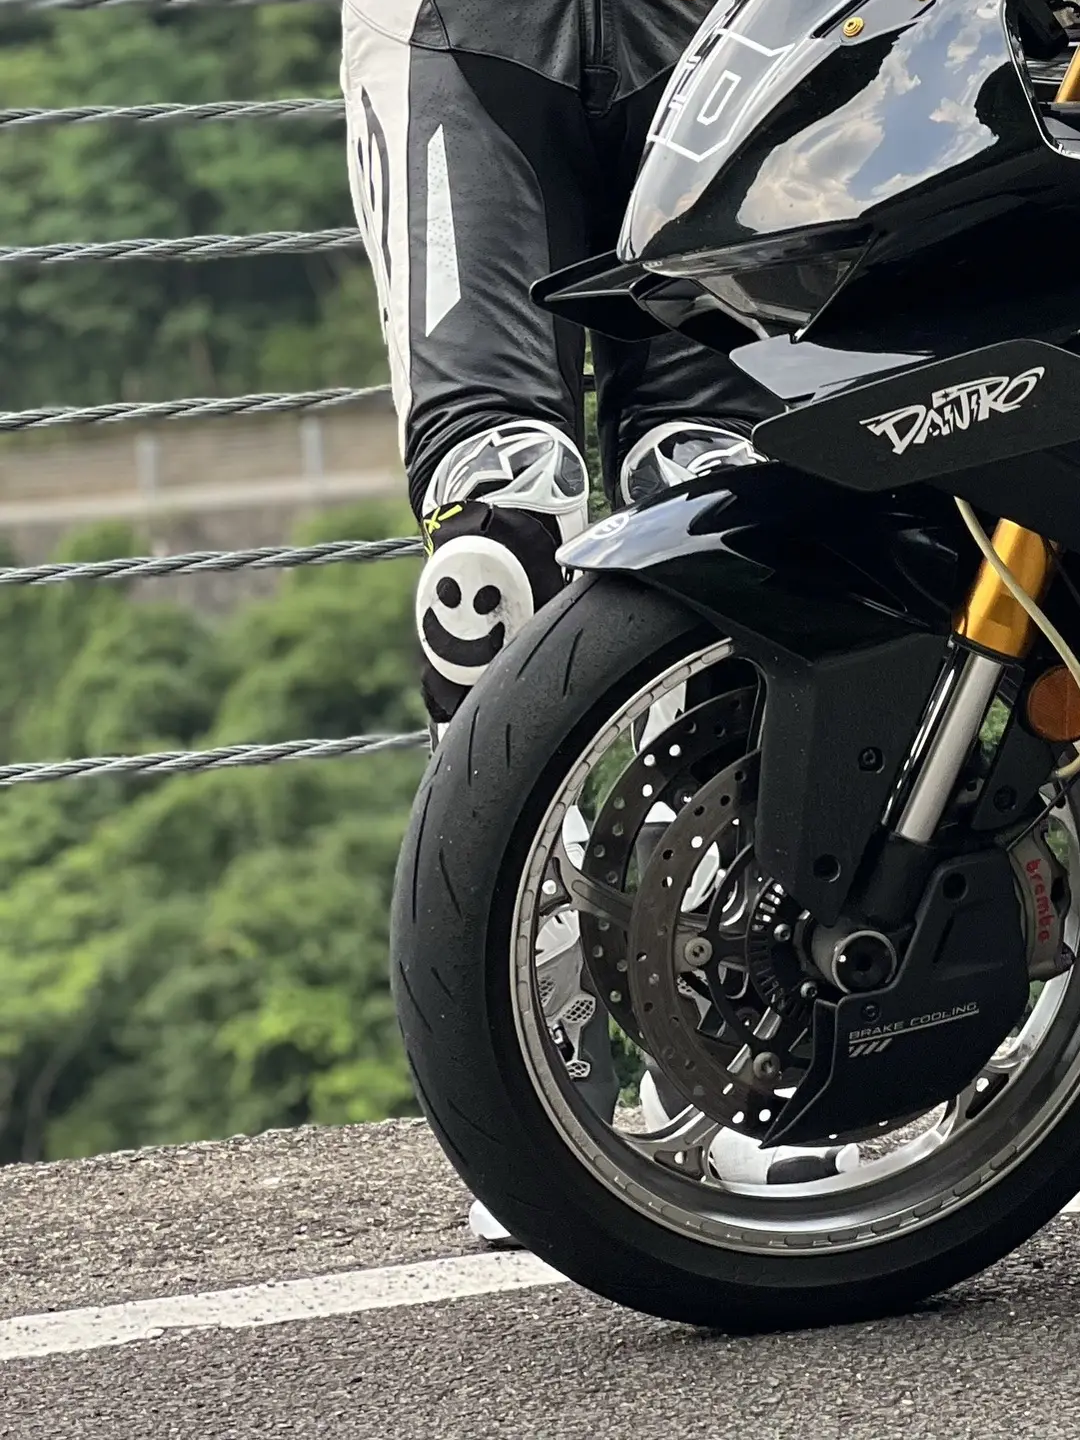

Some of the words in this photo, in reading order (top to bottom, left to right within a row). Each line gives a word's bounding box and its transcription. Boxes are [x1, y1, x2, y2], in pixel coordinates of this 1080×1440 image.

[1026, 858, 1055, 944] brembo
[849, 1021, 904, 1039] BRAKE
[910, 1002, 977, 1026] COOLING
